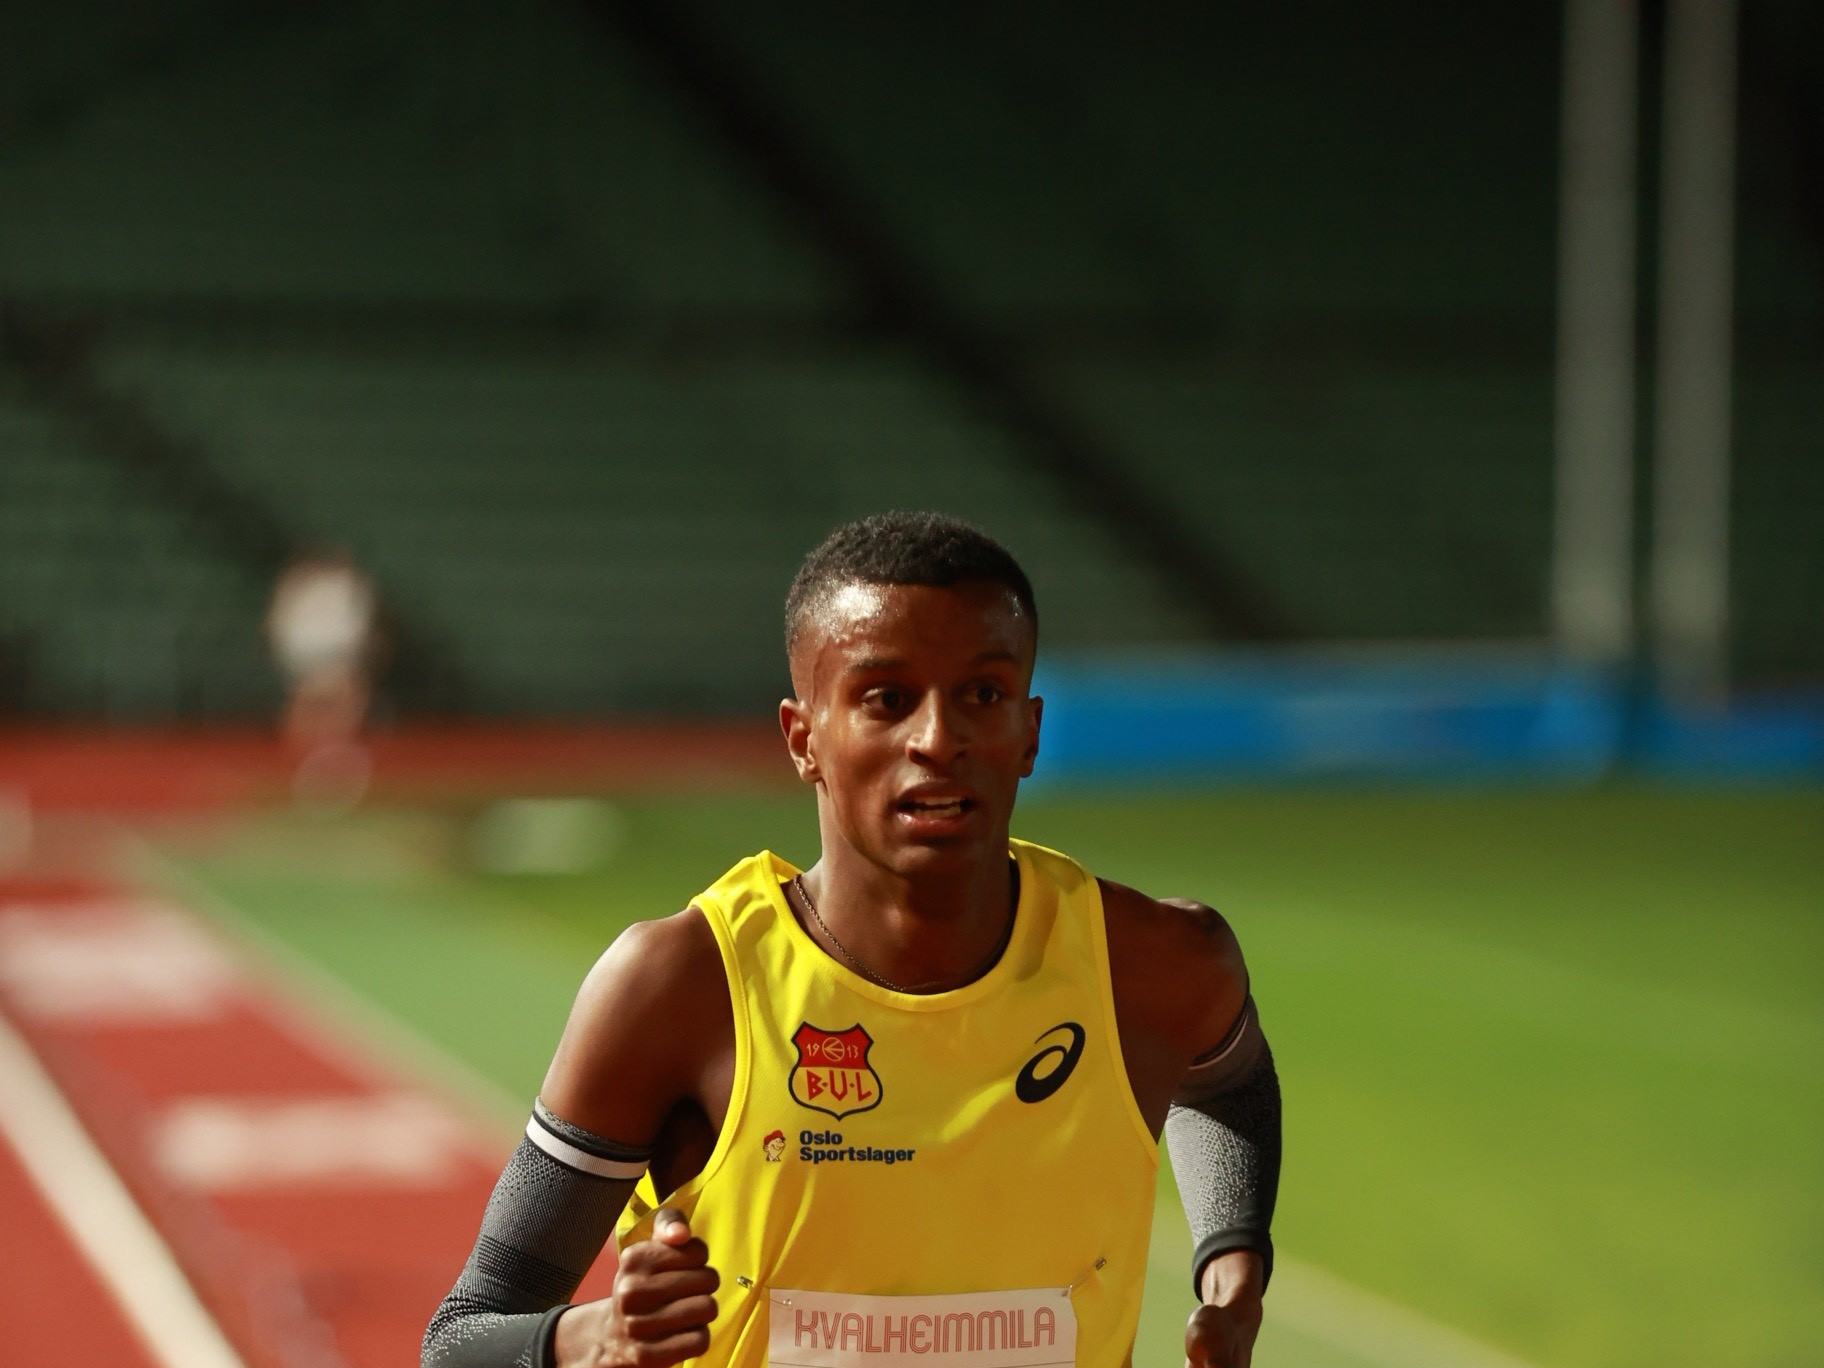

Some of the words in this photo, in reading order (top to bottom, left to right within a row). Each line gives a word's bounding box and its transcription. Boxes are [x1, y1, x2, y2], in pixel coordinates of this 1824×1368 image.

[806, 1043, 820, 1057] 19
[846, 1045, 859, 1059] 13
[799, 1130, 843, 1145] Oslo
[799, 1147, 915, 1164] Sportslager
[795, 1307, 1055, 1354] KVALHEIMMILA
